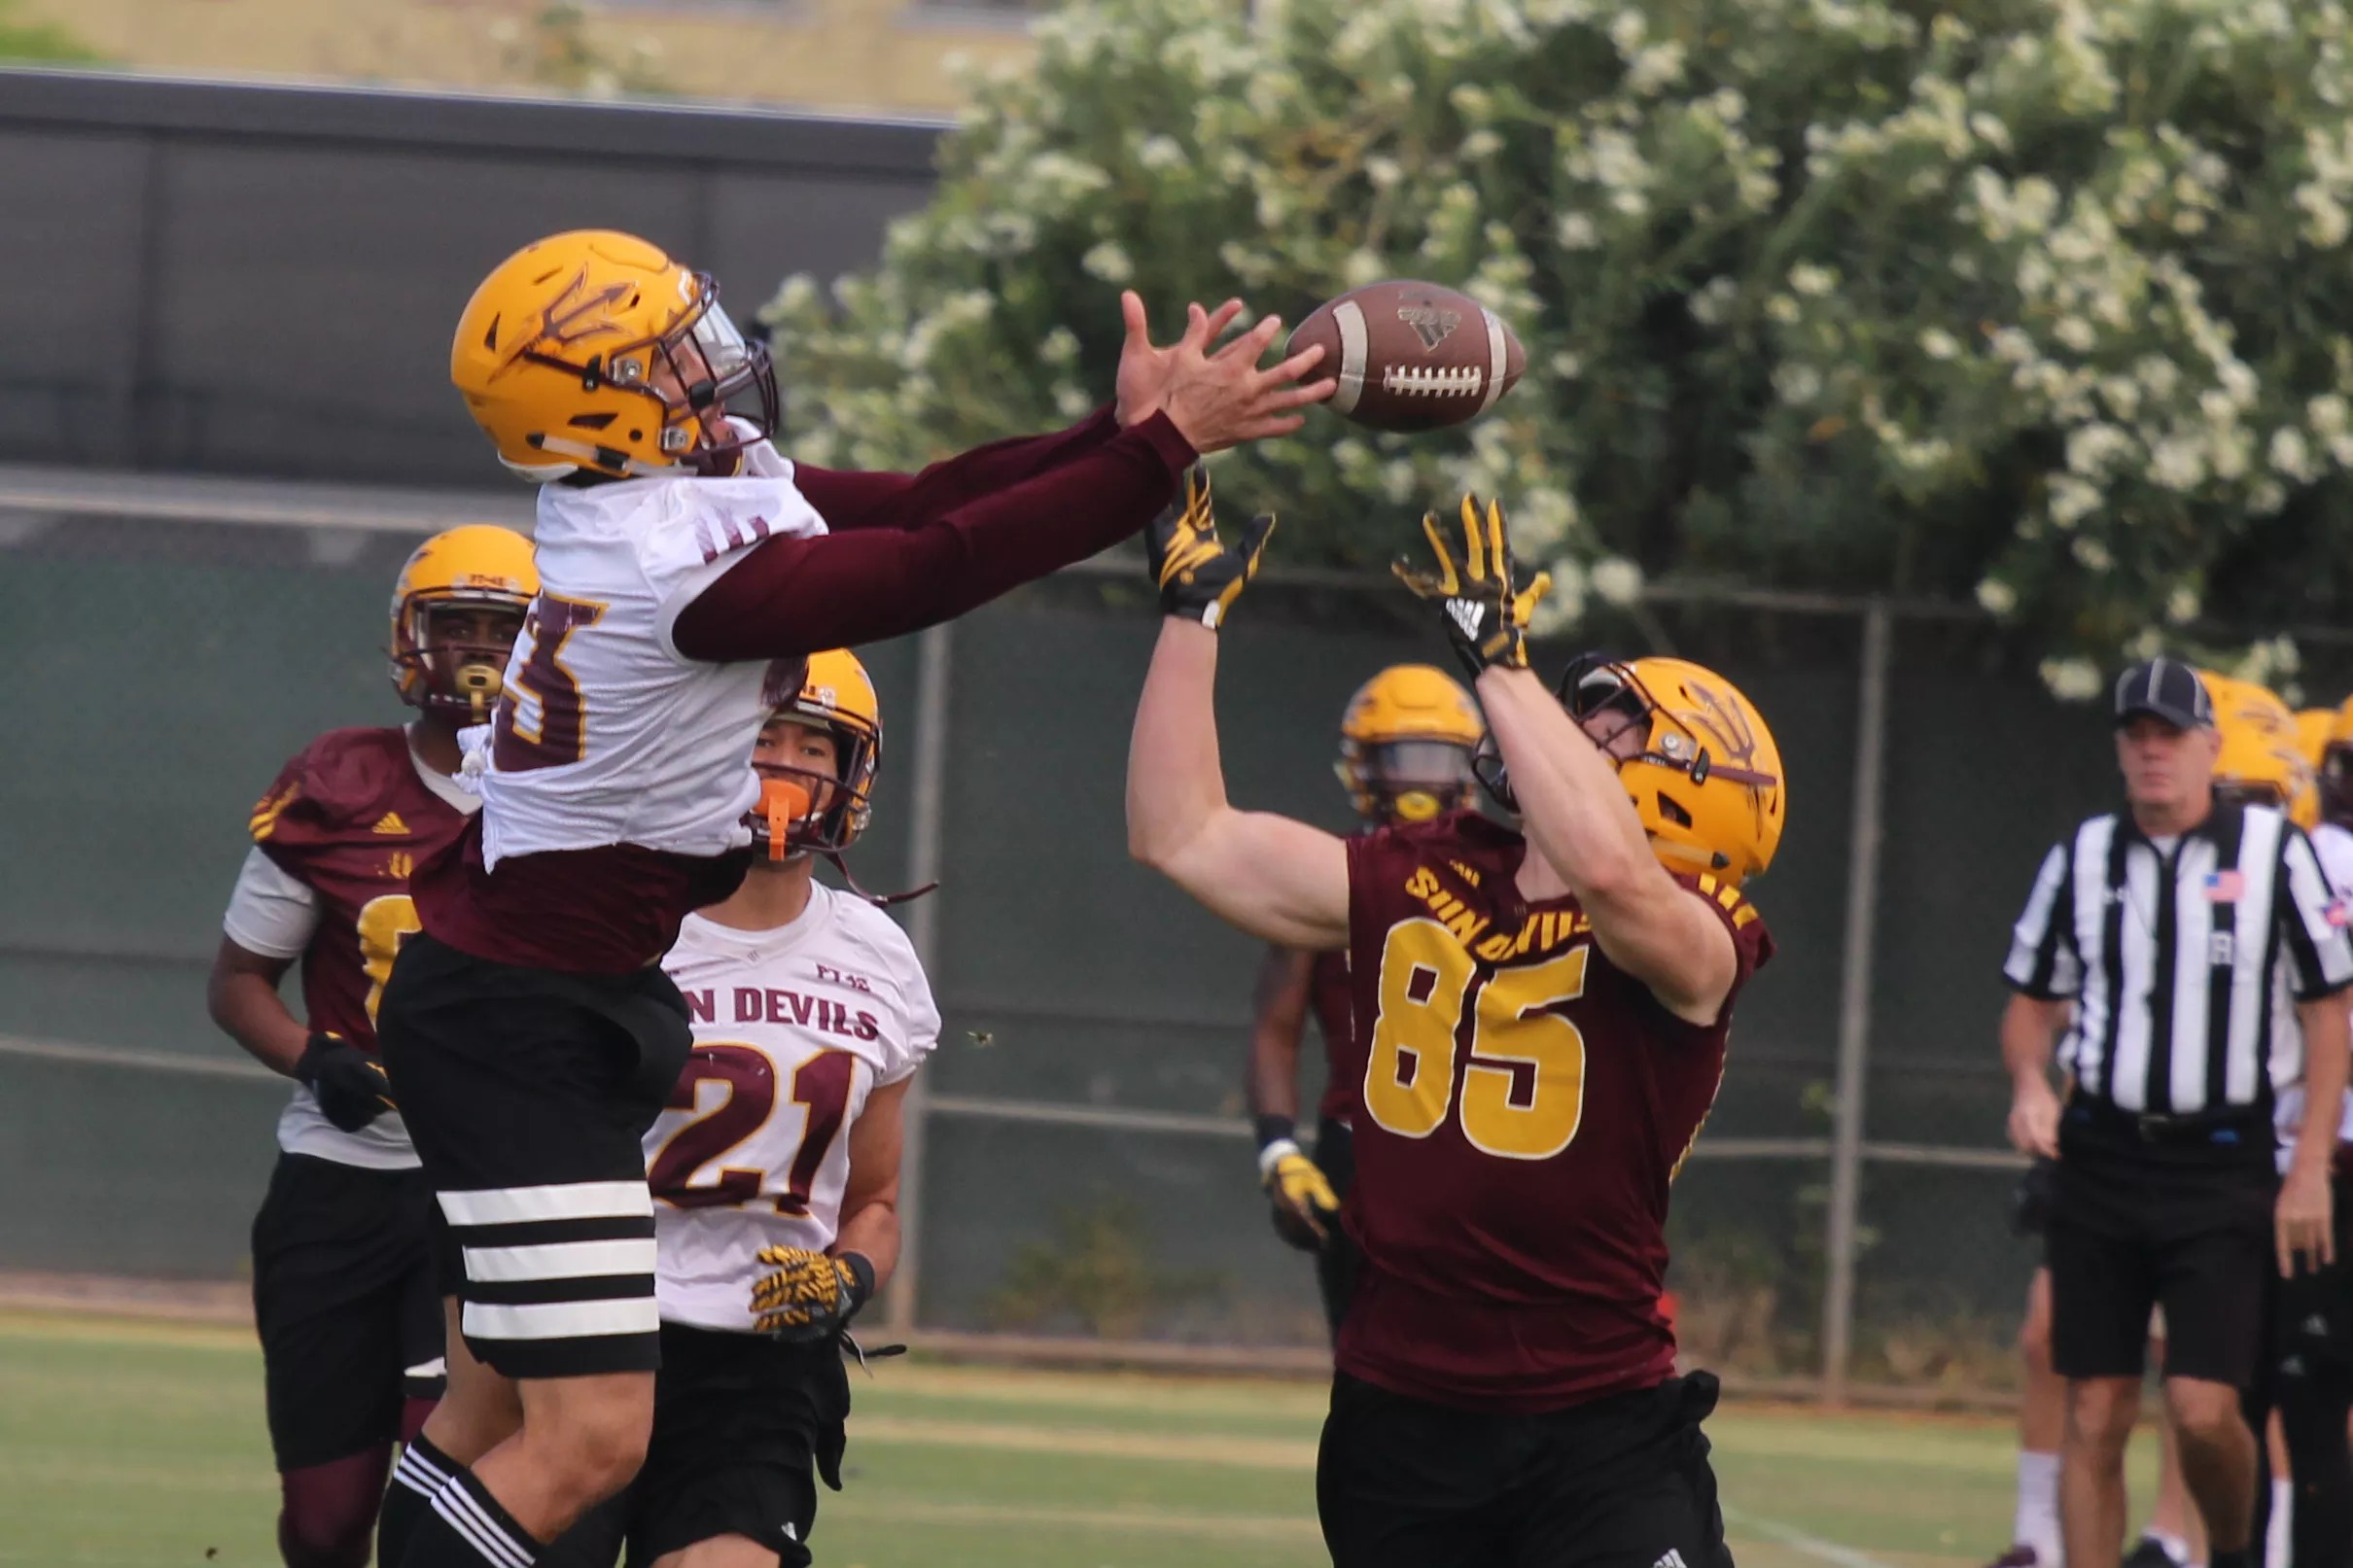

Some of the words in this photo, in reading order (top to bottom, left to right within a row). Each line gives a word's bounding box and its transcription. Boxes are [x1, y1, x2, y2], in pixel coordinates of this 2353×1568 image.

[733, 988, 879, 1041] DEVILS
[1363, 916, 1590, 1161] 85
[646, 1041, 857, 1221] 21
